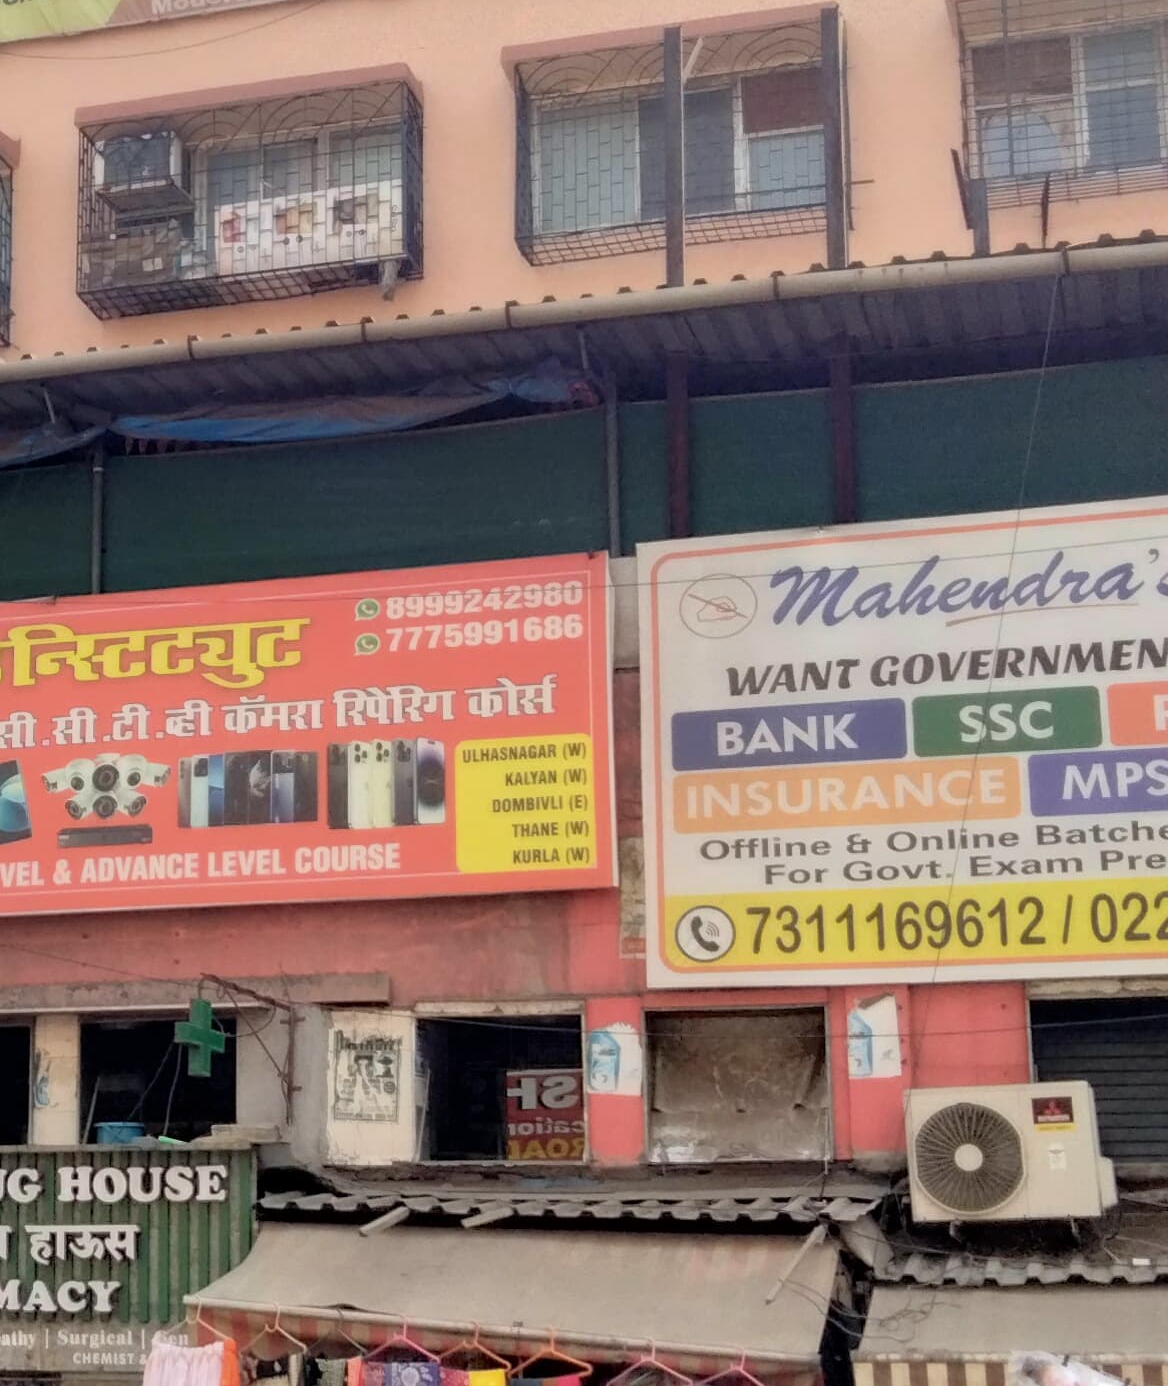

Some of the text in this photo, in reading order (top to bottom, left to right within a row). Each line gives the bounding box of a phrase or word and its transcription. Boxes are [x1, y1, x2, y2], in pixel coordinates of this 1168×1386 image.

[385, 580, 584, 622] 8999242980
[385, 613, 584, 653] 7775991686
[464, 673, 558, 719] कोर्स
[727, 658, 860, 697] WANT
[716, 700, 1055, 757] BANK SSC
[462, 740, 588, 764] ULHASNAGAR (W)
[504, 766, 588, 787] KALYAN (W)
[686, 768, 1007, 820] INSURANCE
[492, 793, 589, 814] DOMBIVLI (E)
[512, 819, 590, 839] THANE (W)
[699, 832, 832, 862] Offline
[846, 833, 872, 856] &
[886, 826, 1021, 854] Online
[52, 858, 72, 885] &
[80, 852, 199, 884] ADVANCE
[207, 846, 287, 878] LEVEL
[295, 842, 401, 874] COURSE
[512, 846, 591, 866] KURLA (W)
[764, 862, 829, 886] For
[842, 857, 955, 883] Govt.
[970, 853, 1085, 878] Exam
[745, 894, 1047, 955] 7311169612
[57, 1164, 229, 1203] HOUSE
[23, 1223, 141, 1262] हाऊस
[57, 1327, 133, 1349] Surgical
[73, 1352, 134, 1366] CHEMIST
